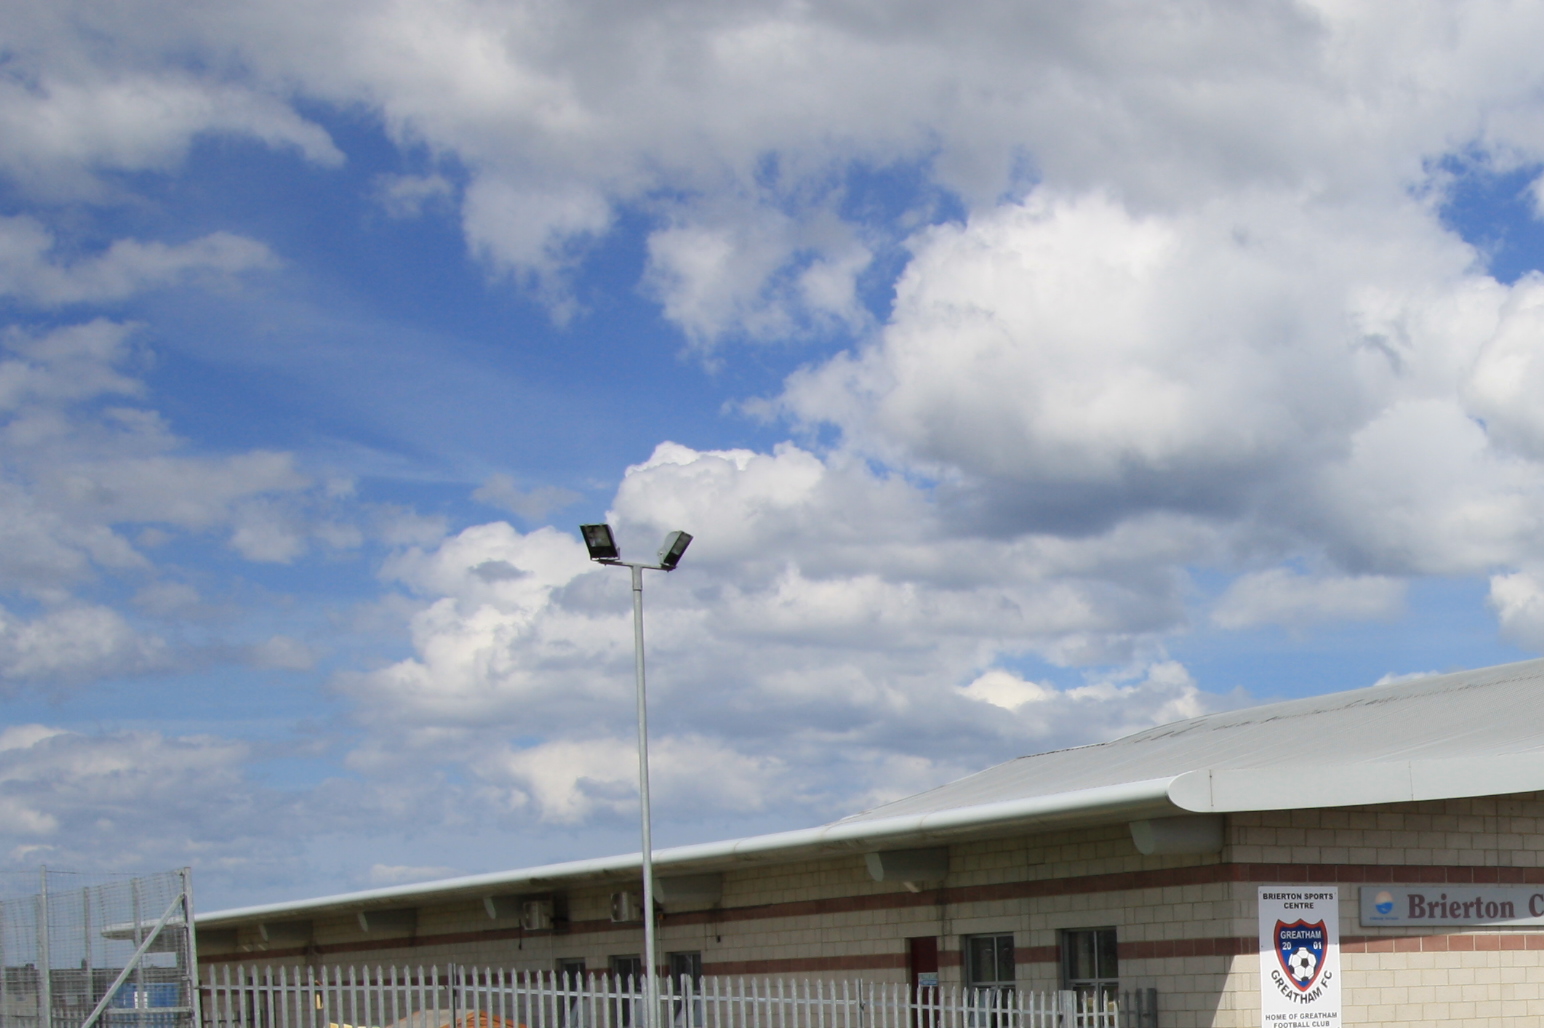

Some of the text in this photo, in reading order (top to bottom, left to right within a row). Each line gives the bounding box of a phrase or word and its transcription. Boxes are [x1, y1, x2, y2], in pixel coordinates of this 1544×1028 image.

[1407, 893, 1515, 919] Brierton
[1280, 930, 1322, 940] GREATHAM
[1282, 941, 1322, 950] 20 01
[1271, 969, 1333, 1004] GREATHAM FC
[1265, 1013, 1287, 1021] HOME
[1300, 1012, 1337, 1020] GREATHAM
[1273, 1021, 1310, 1028] FOOTBALL
